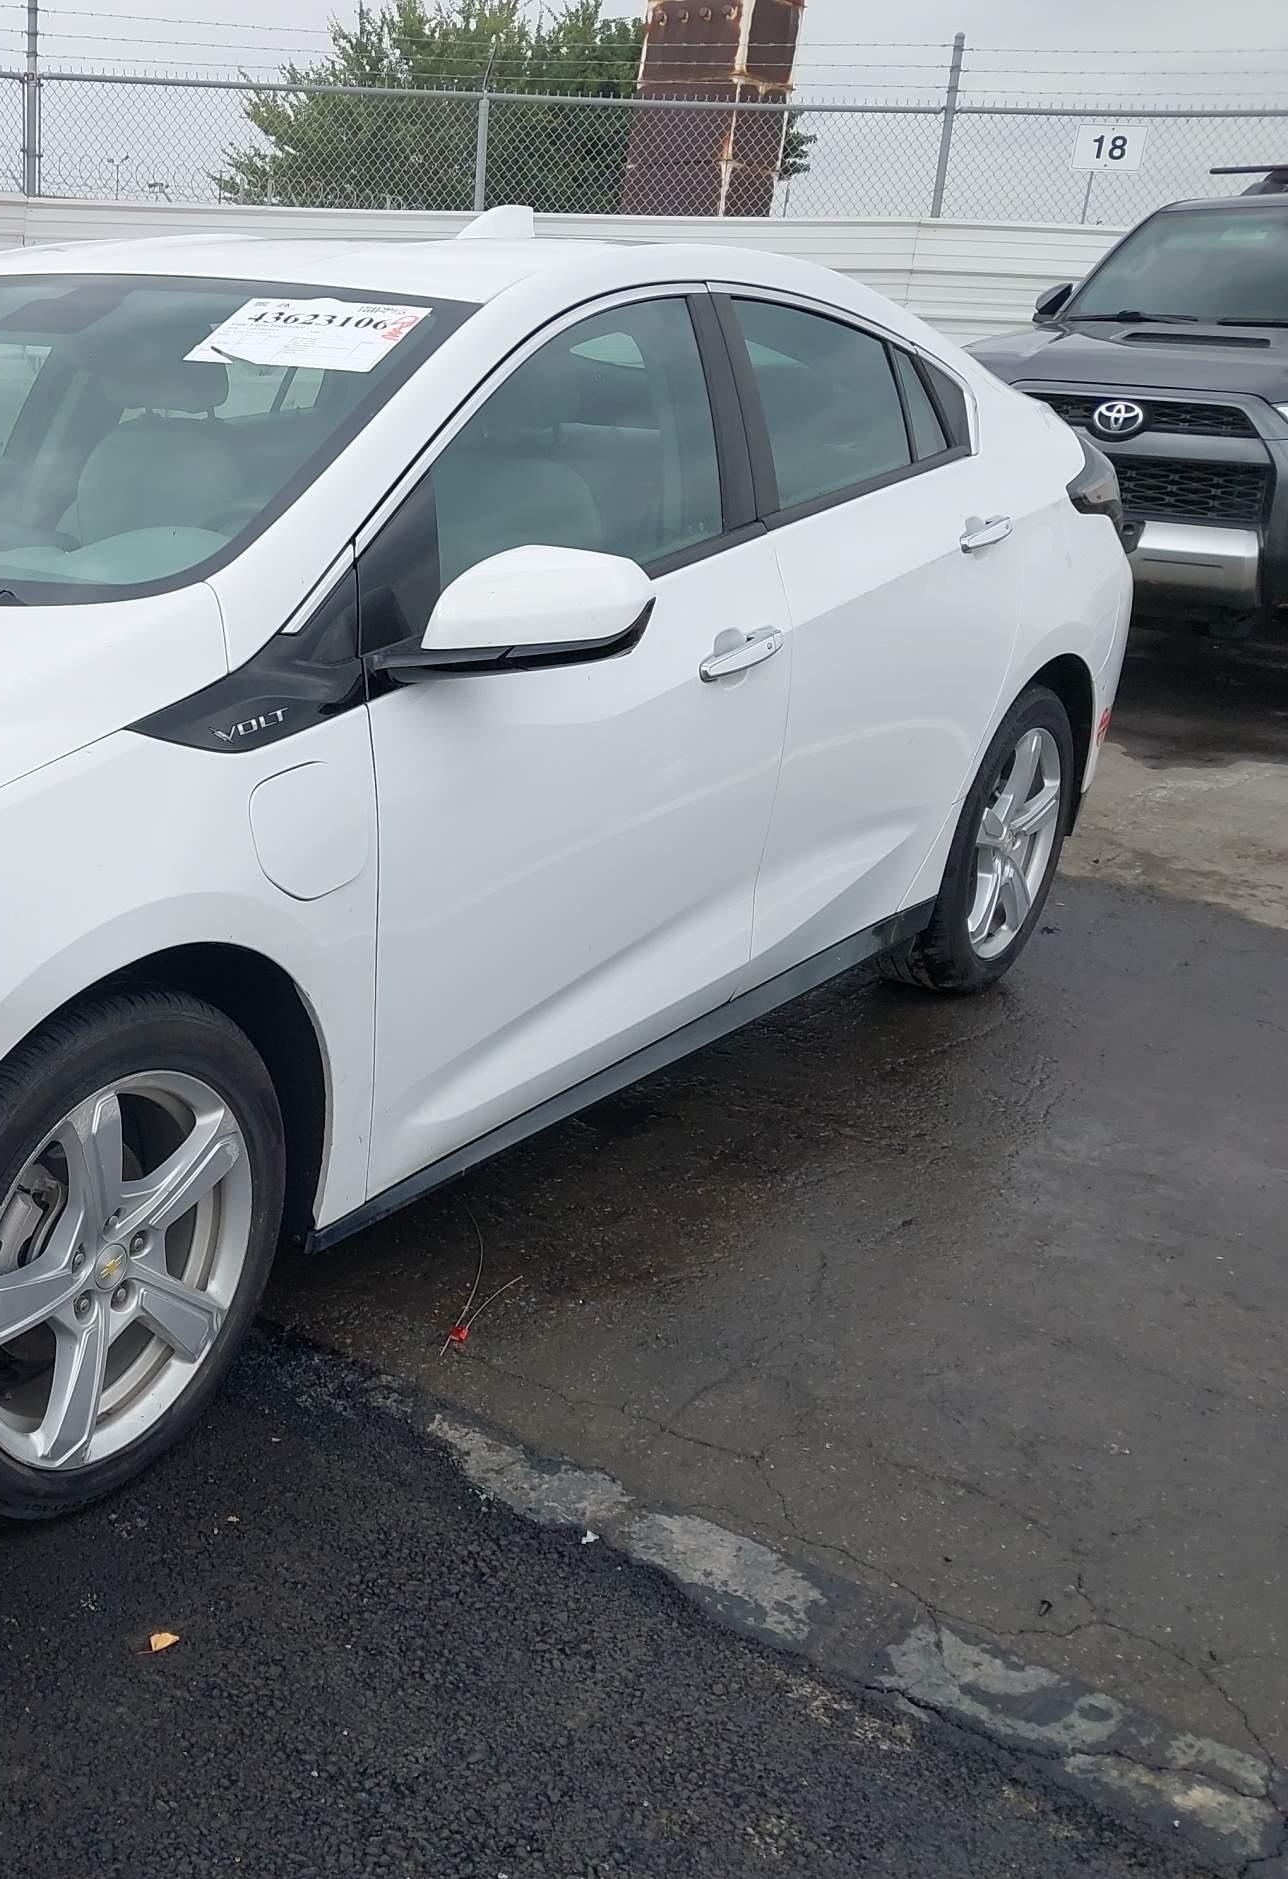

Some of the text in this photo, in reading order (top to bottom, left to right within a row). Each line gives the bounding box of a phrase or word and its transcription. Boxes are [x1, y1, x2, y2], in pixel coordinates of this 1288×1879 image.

[1093, 134, 1128, 161] 18
[248, 311, 388, 331] 43623106
[209, 706, 289, 744] VOLT
